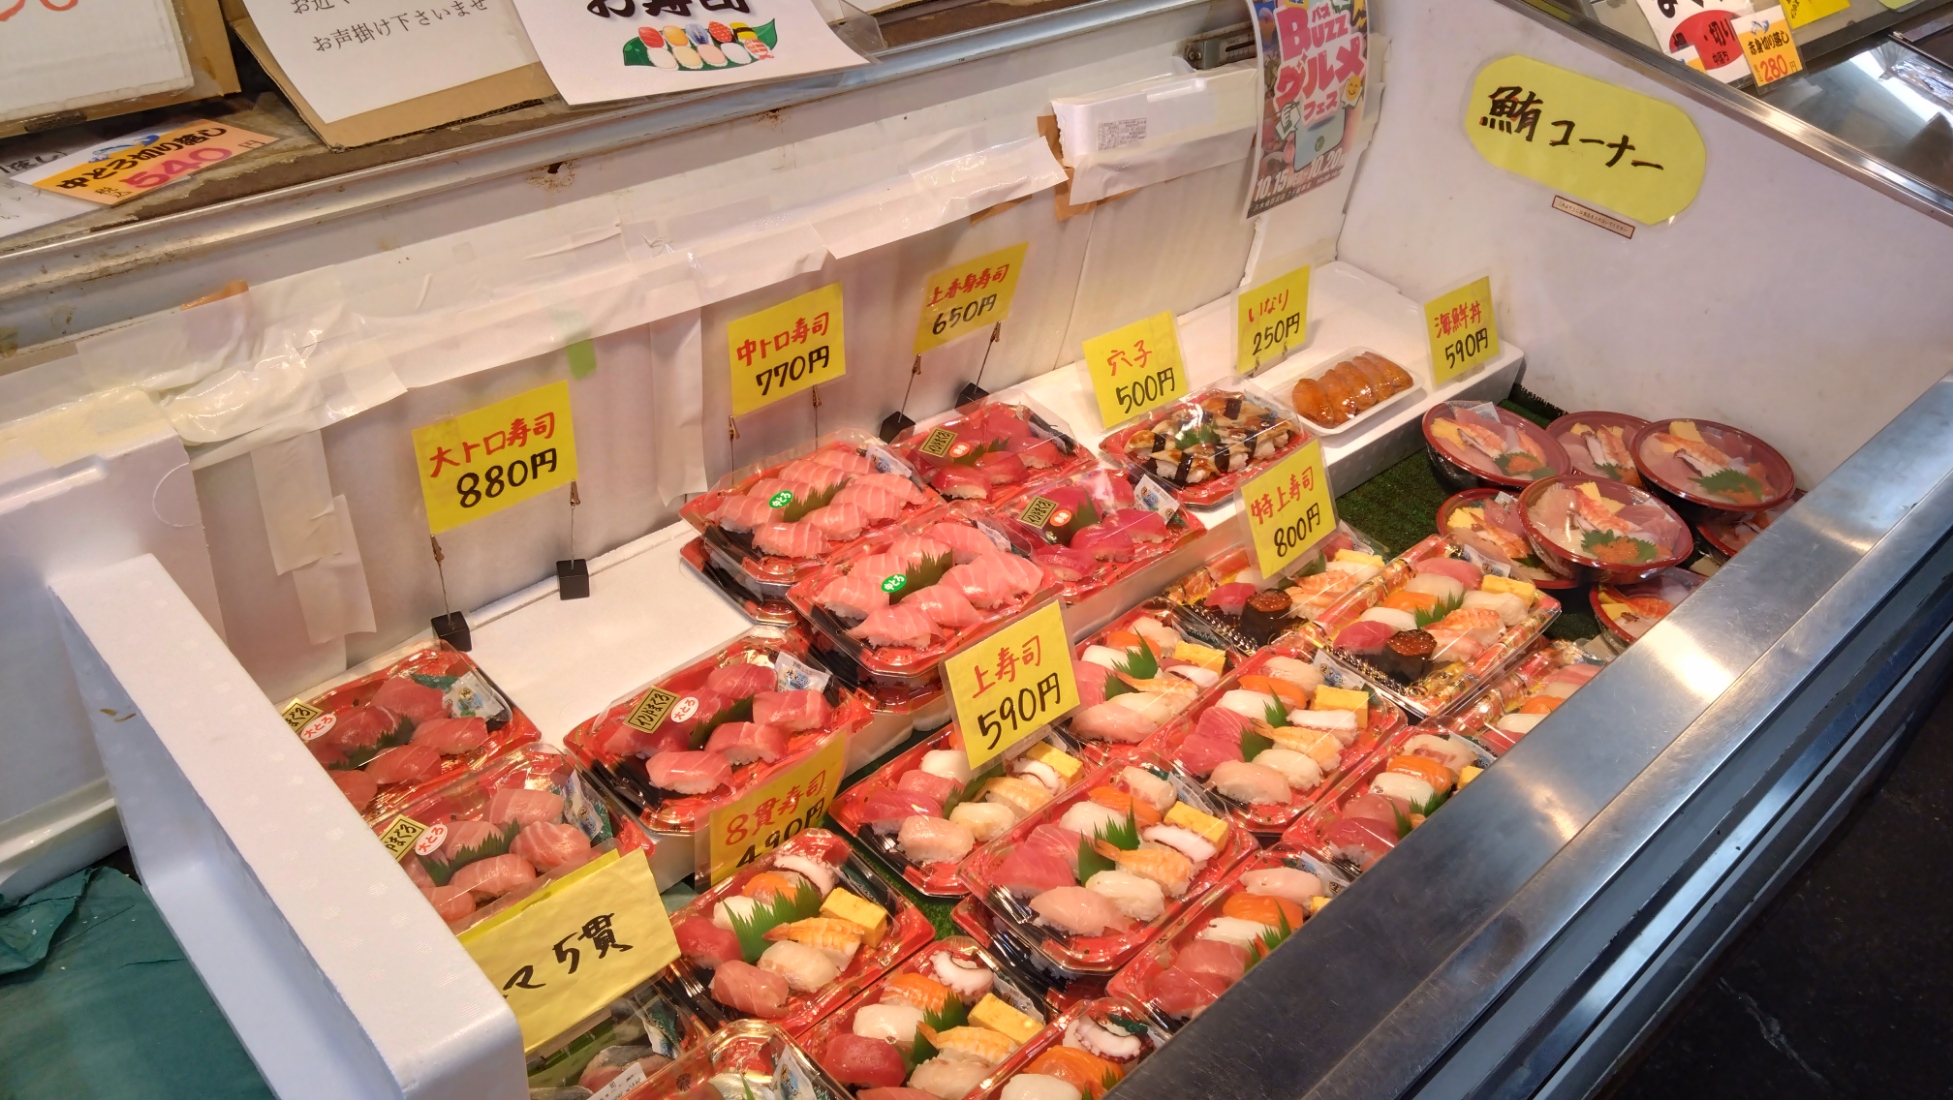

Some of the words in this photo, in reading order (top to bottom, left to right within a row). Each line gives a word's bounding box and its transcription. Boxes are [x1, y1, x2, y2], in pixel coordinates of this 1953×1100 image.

[291, 0, 350, 14] お近
[313, 0, 488, 52] お声掛け下さいませ
[1275, 36, 1365, 112] グルメ
[1304, 90, 1338, 121] フェス
[55, 127, 228, 190] 中とろ切り落し
[932, 293, 997, 335] 650円
[1248, 289, 1289, 323] いなり
[1434, 300, 1482, 338] 海鮮丼
[736, 312, 829, 366] 中トロ寿司
[1107, 340, 1152, 376] 穴子
[1252, 312, 1300, 356] 250円
[1445, 327, 1488, 369] 590円
[755, 345, 829, 396] 770円
[1116, 367, 1175, 414] 500円
[429, 412, 555, 478] 大トロ寿司
[457, 448, 557, 508] 880円
[1250, 466, 1314, 525] 特上寿司
[1274, 502, 1320, 557] 800円
[972, 635, 1042, 699] 上寿司
[304, 716, 333, 738] 大とろ
[674, 699, 696, 720] 大とろ
[977, 672, 1061, 750] 590円
[725, 770, 826, 846] 8貫寿司
[735, 797, 825, 868] 490円
[384, 823, 417, 853] ドまぐろ
[419, 827, 444, 852] 大とろ
